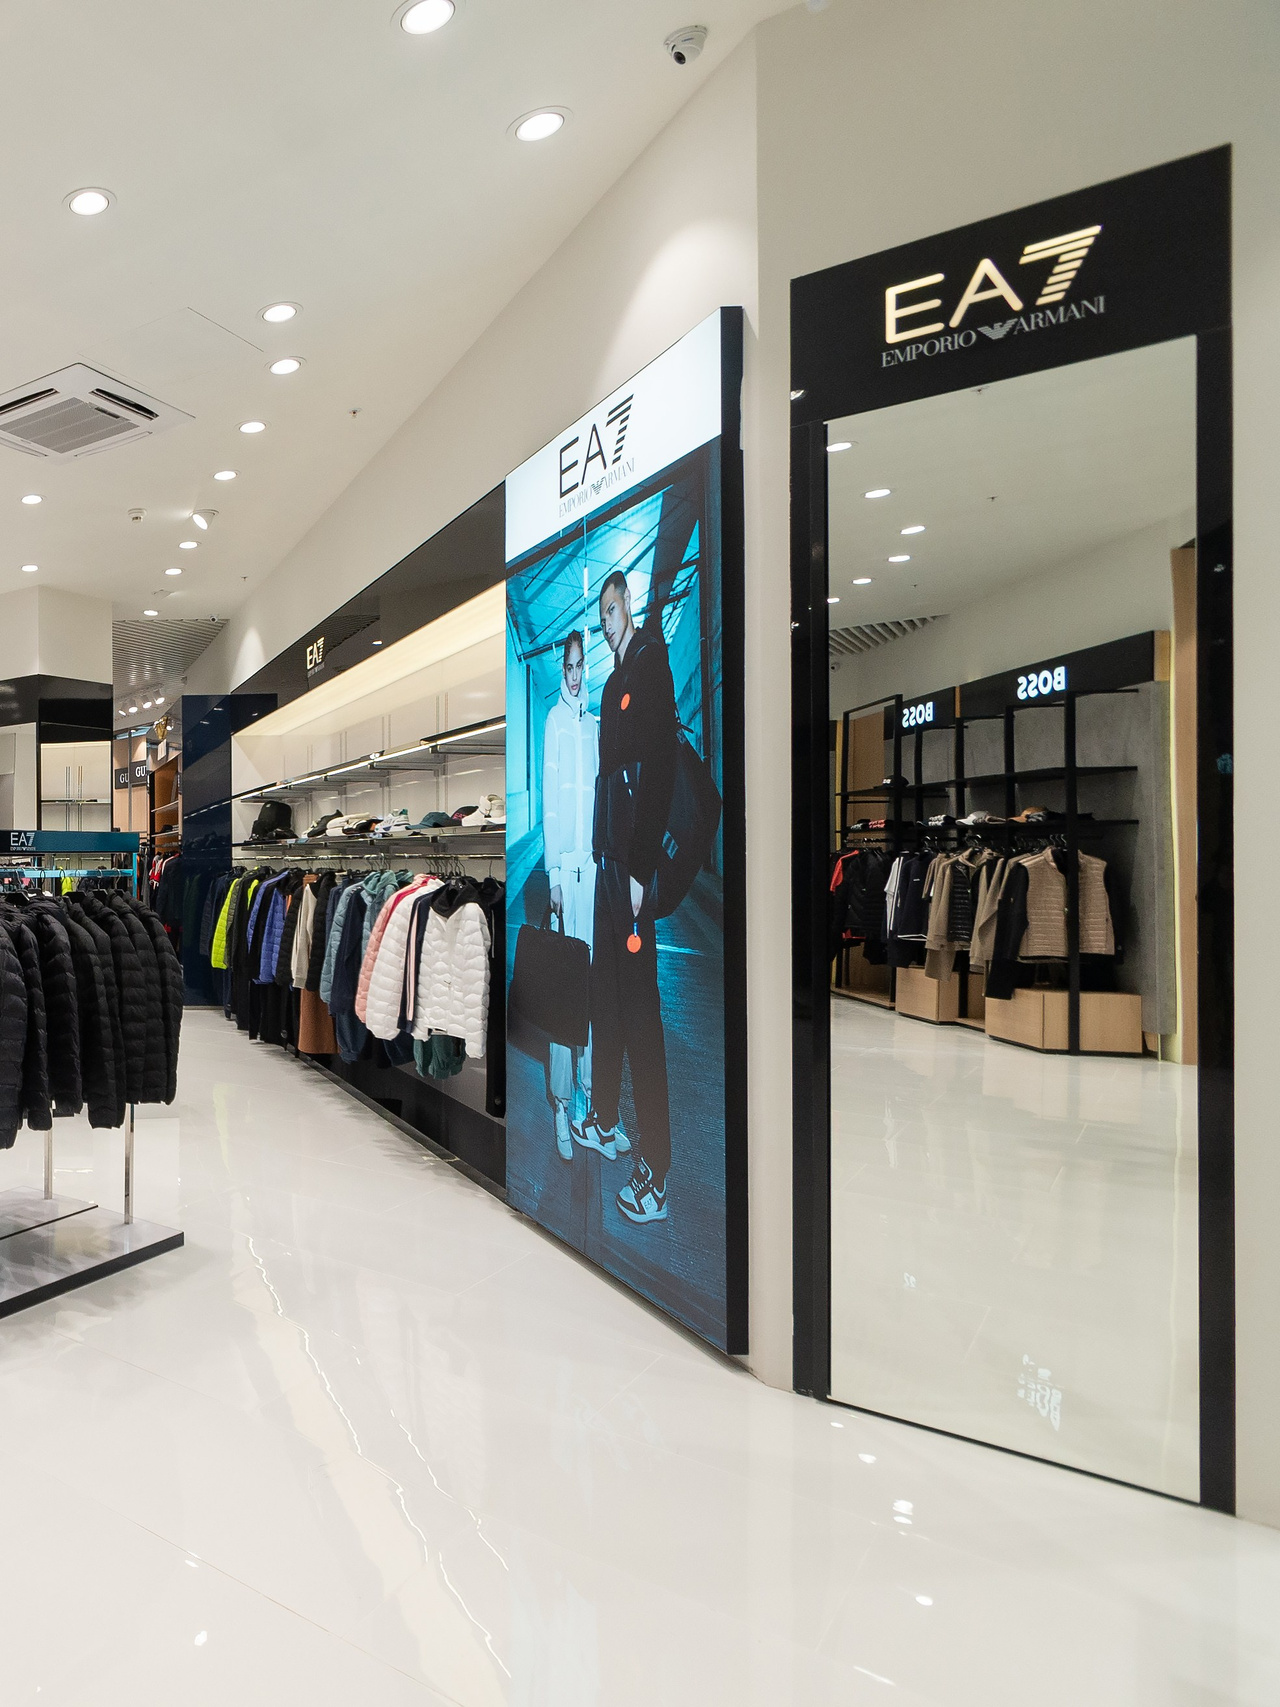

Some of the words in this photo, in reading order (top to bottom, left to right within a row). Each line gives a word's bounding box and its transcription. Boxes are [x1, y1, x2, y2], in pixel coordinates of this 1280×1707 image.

[885, 224, 1102, 344] EA7
[881, 330, 977, 368] EMPORIO
[1012, 295, 1106, 335] ARMANI
[559, 393, 634, 498] EA7
[558, 485, 593, 518] EMPORIO
[603, 457, 635, 489] ARMANI
[306, 636, 325, 670] EA7
[10, 832, 35, 846] EA7
